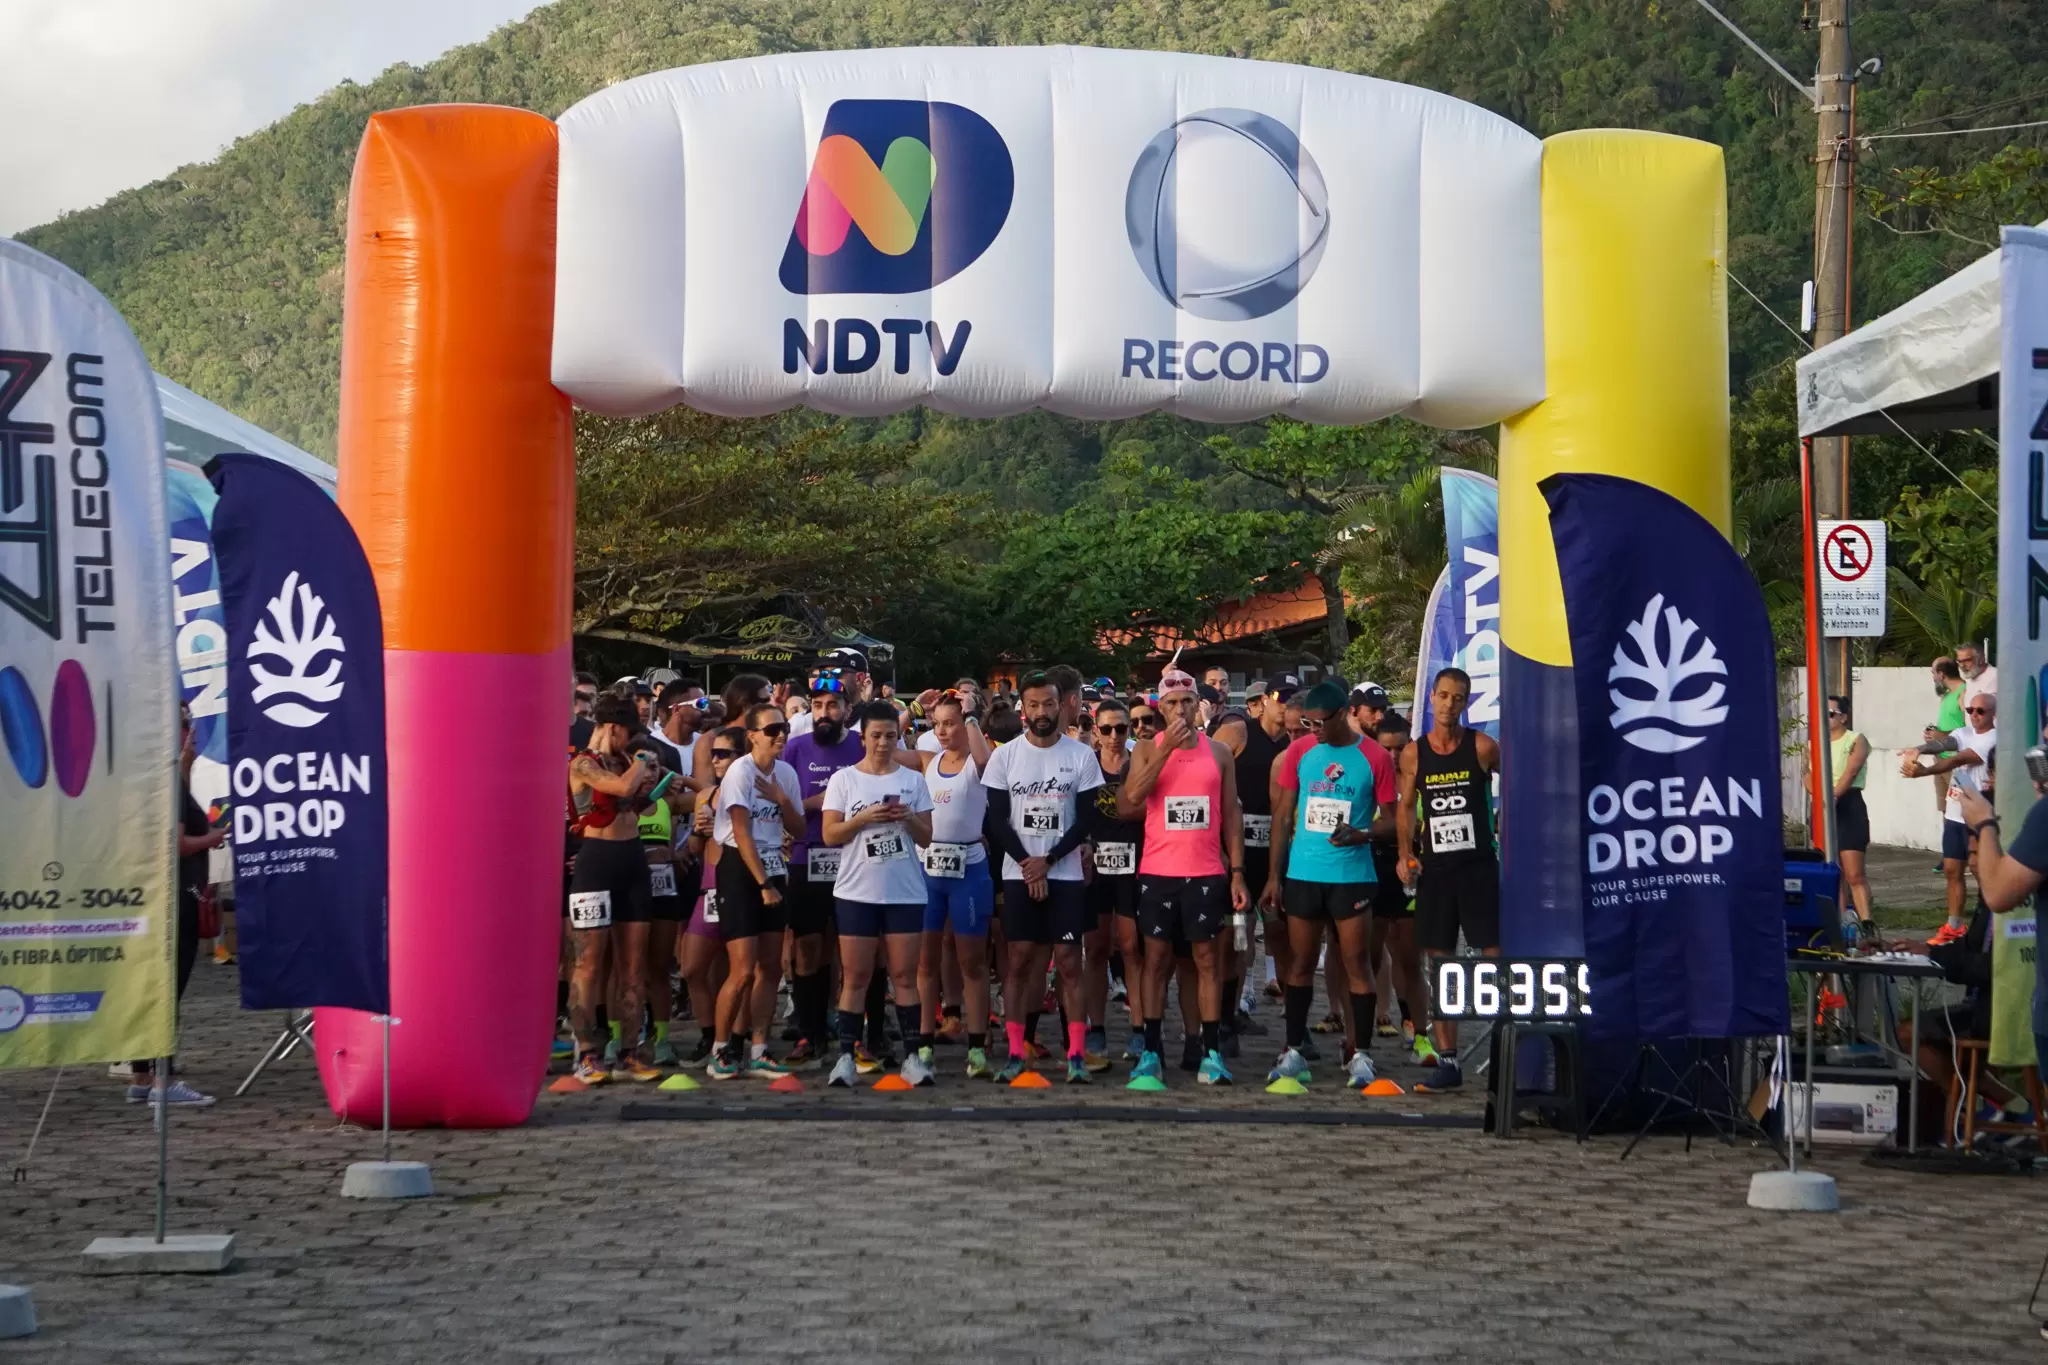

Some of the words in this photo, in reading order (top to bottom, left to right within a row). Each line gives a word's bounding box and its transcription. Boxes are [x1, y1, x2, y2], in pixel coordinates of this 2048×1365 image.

[782, 317, 972, 375] NDTV
[1121, 338, 1330, 383] RECORD
[170, 537, 228, 719] NDTV
[1831, 619, 1869, 630] Motorhome
[1464, 545, 1500, 725] NDTV
[775, 652, 793, 662] ON
[233, 752, 370, 798] OCEAN
[1588, 776, 1763, 825] OCEAN
[234, 799, 345, 844] DROP
[1031, 815, 1053, 829] 321
[1175, 809, 1199, 823] 367
[1251, 828, 1269, 840] 315
[236, 851, 267, 864] YOUR
[873, 840, 898, 856] 388
[1588, 824, 1733, 873] DROP
[239, 866, 262, 877] OUR
[263, 861, 306, 876] CAUSE
[931, 856, 955, 870] 344
[1102, 855, 1126, 868] 406
[1591, 880, 1627, 893] YOUR
[1631, 873, 1727, 889] SUPERPOWER,
[0, 889, 61, 910] 4042
[80, 887, 145, 909] 3042
[1591, 894, 1620, 907] OUR
[1624, 889, 1668, 904] CAUSE
[13, 949, 62, 966] FIBRA
[66, 944, 126, 964] ÓPTICA
